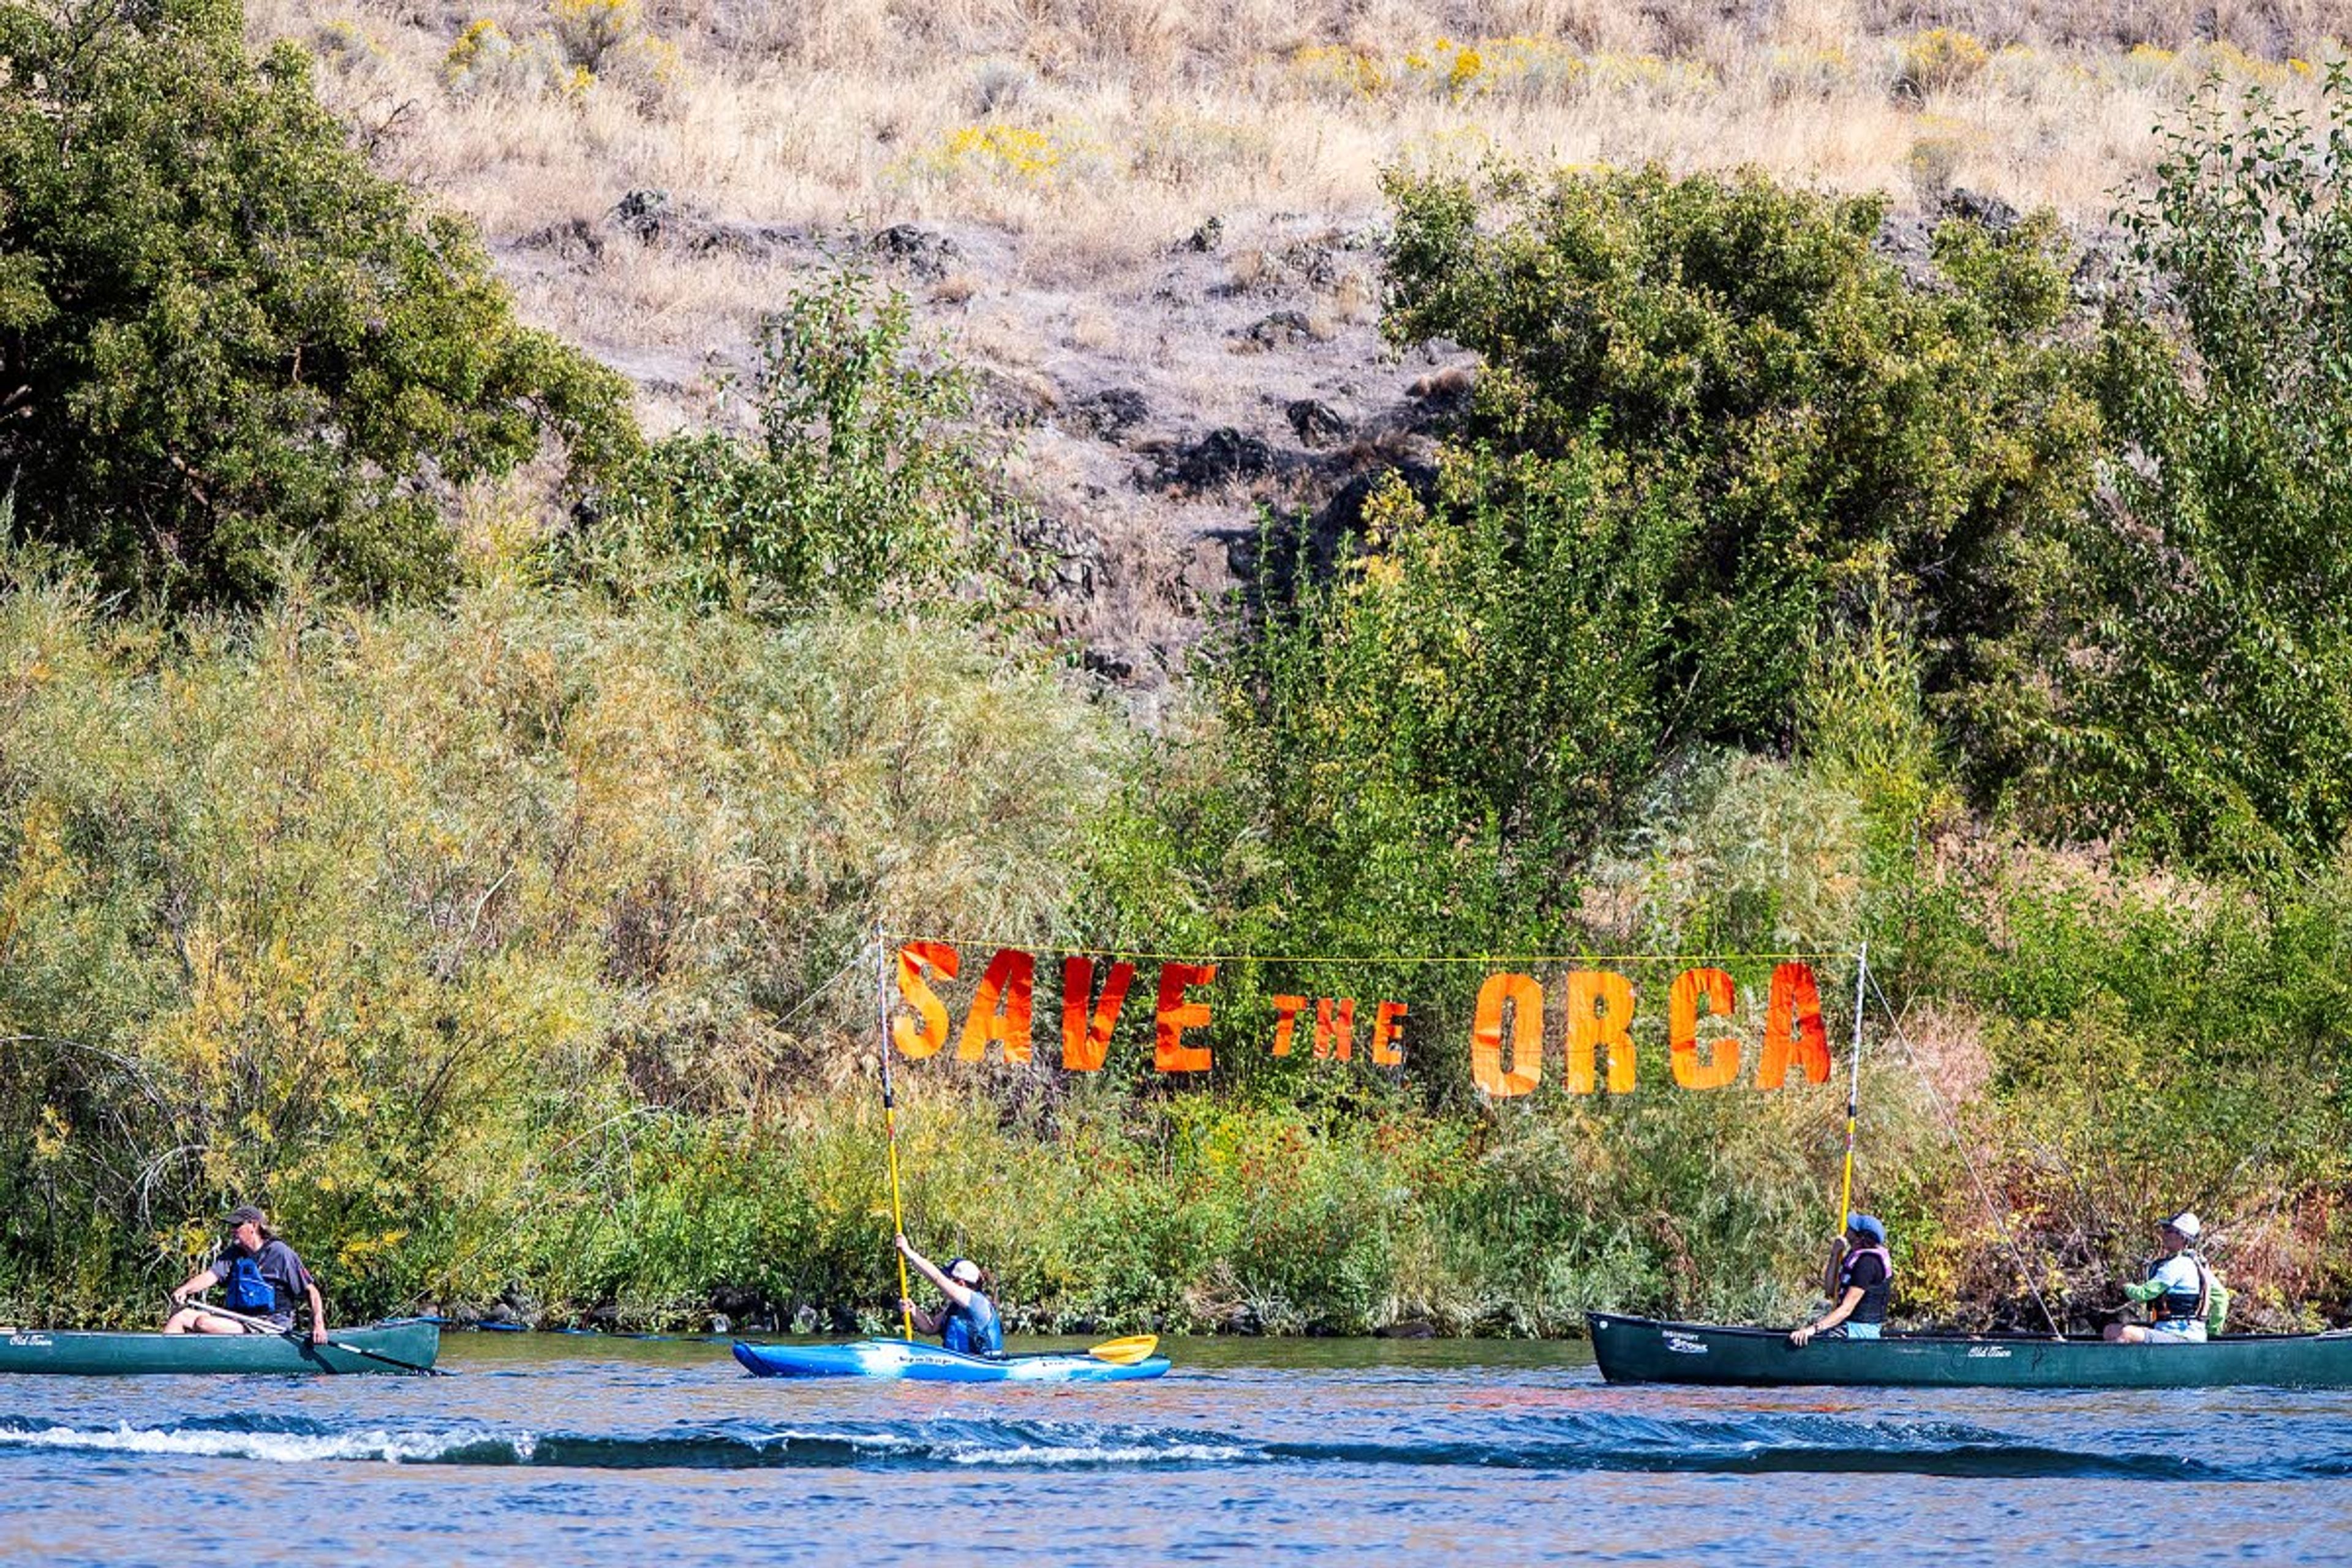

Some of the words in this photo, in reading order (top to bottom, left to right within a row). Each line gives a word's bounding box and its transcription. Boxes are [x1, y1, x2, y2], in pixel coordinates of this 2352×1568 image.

[892, 941, 1217, 1072] SAVE
[1272, 995, 1409, 1065] THE
[1471, 962, 1832, 1096] ORCA
